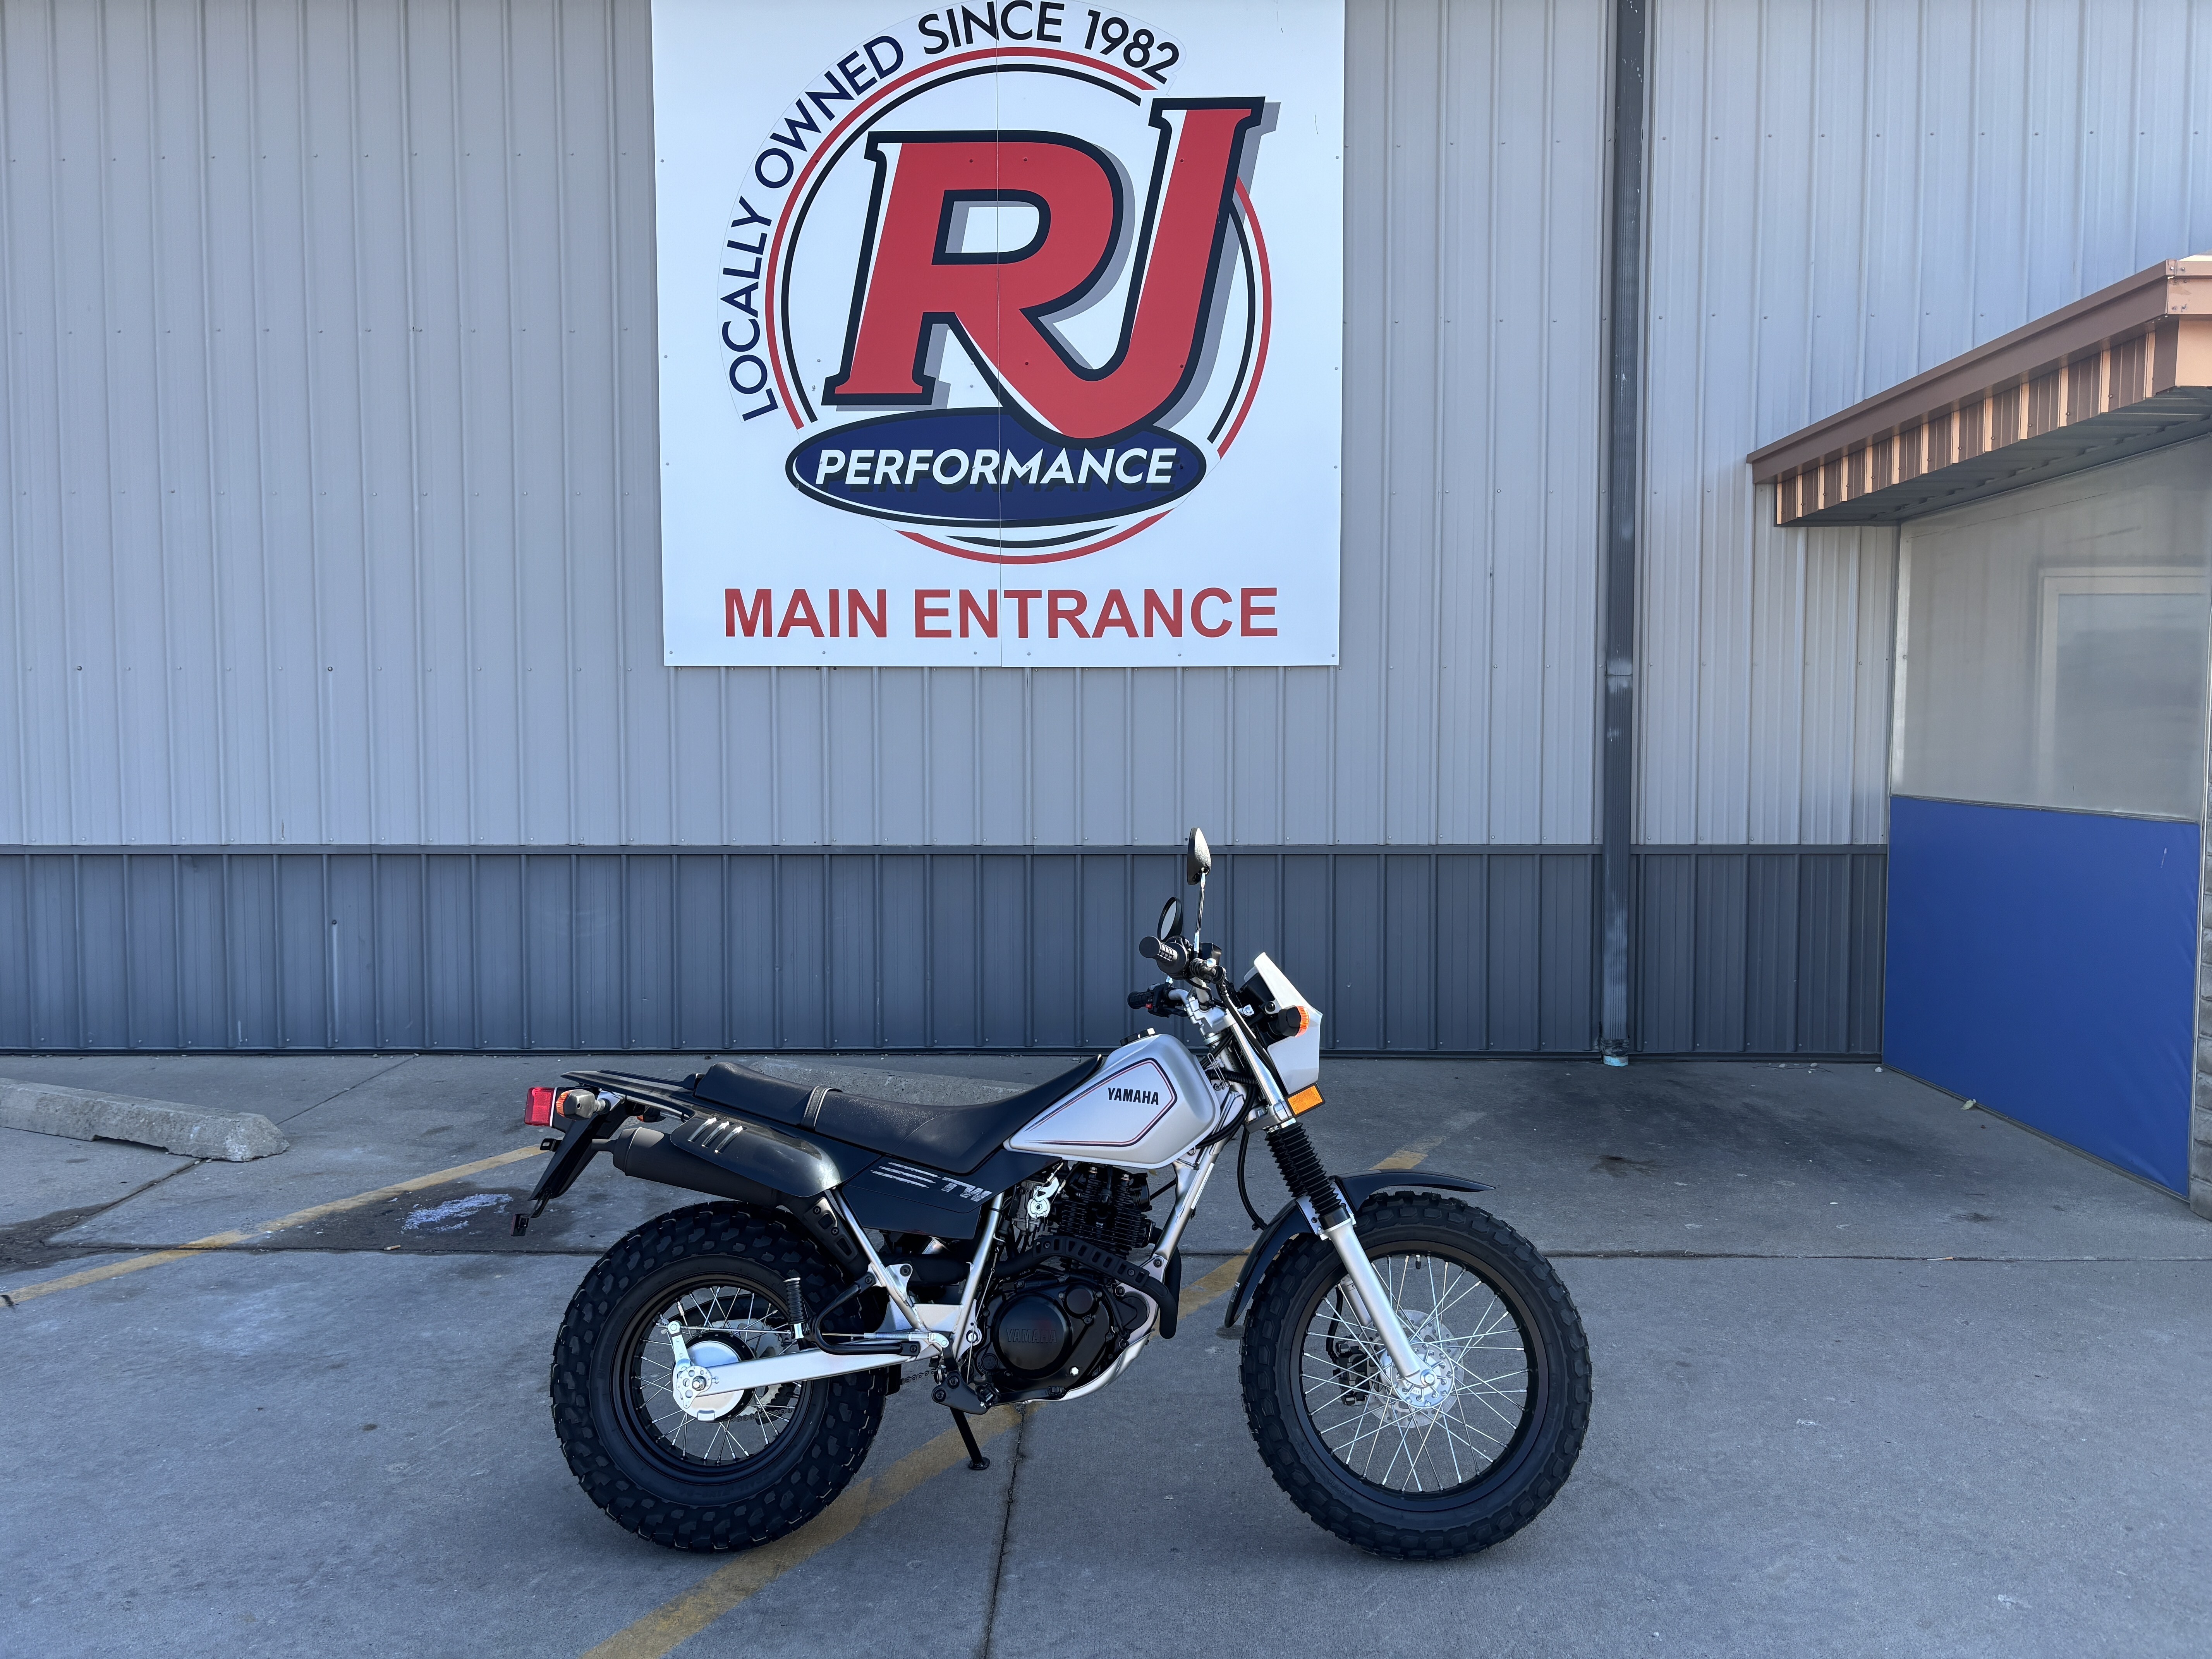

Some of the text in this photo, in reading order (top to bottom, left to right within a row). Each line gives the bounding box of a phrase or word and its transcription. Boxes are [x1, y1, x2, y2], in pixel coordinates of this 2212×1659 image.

[720, 0, 1179, 421] LOCALLY OWNED SINCE 1982
[821, 96, 1266, 445] RJ
[815, 447, 1177, 485] PERFORMANCE
[725, 588, 1278, 638] MAIN ENTRANCE
[1108, 1087, 1159, 1106] YAMAHA
[941, 1176, 993, 1202] TW
[1006, 1328, 1057, 1343] YAMAHA
